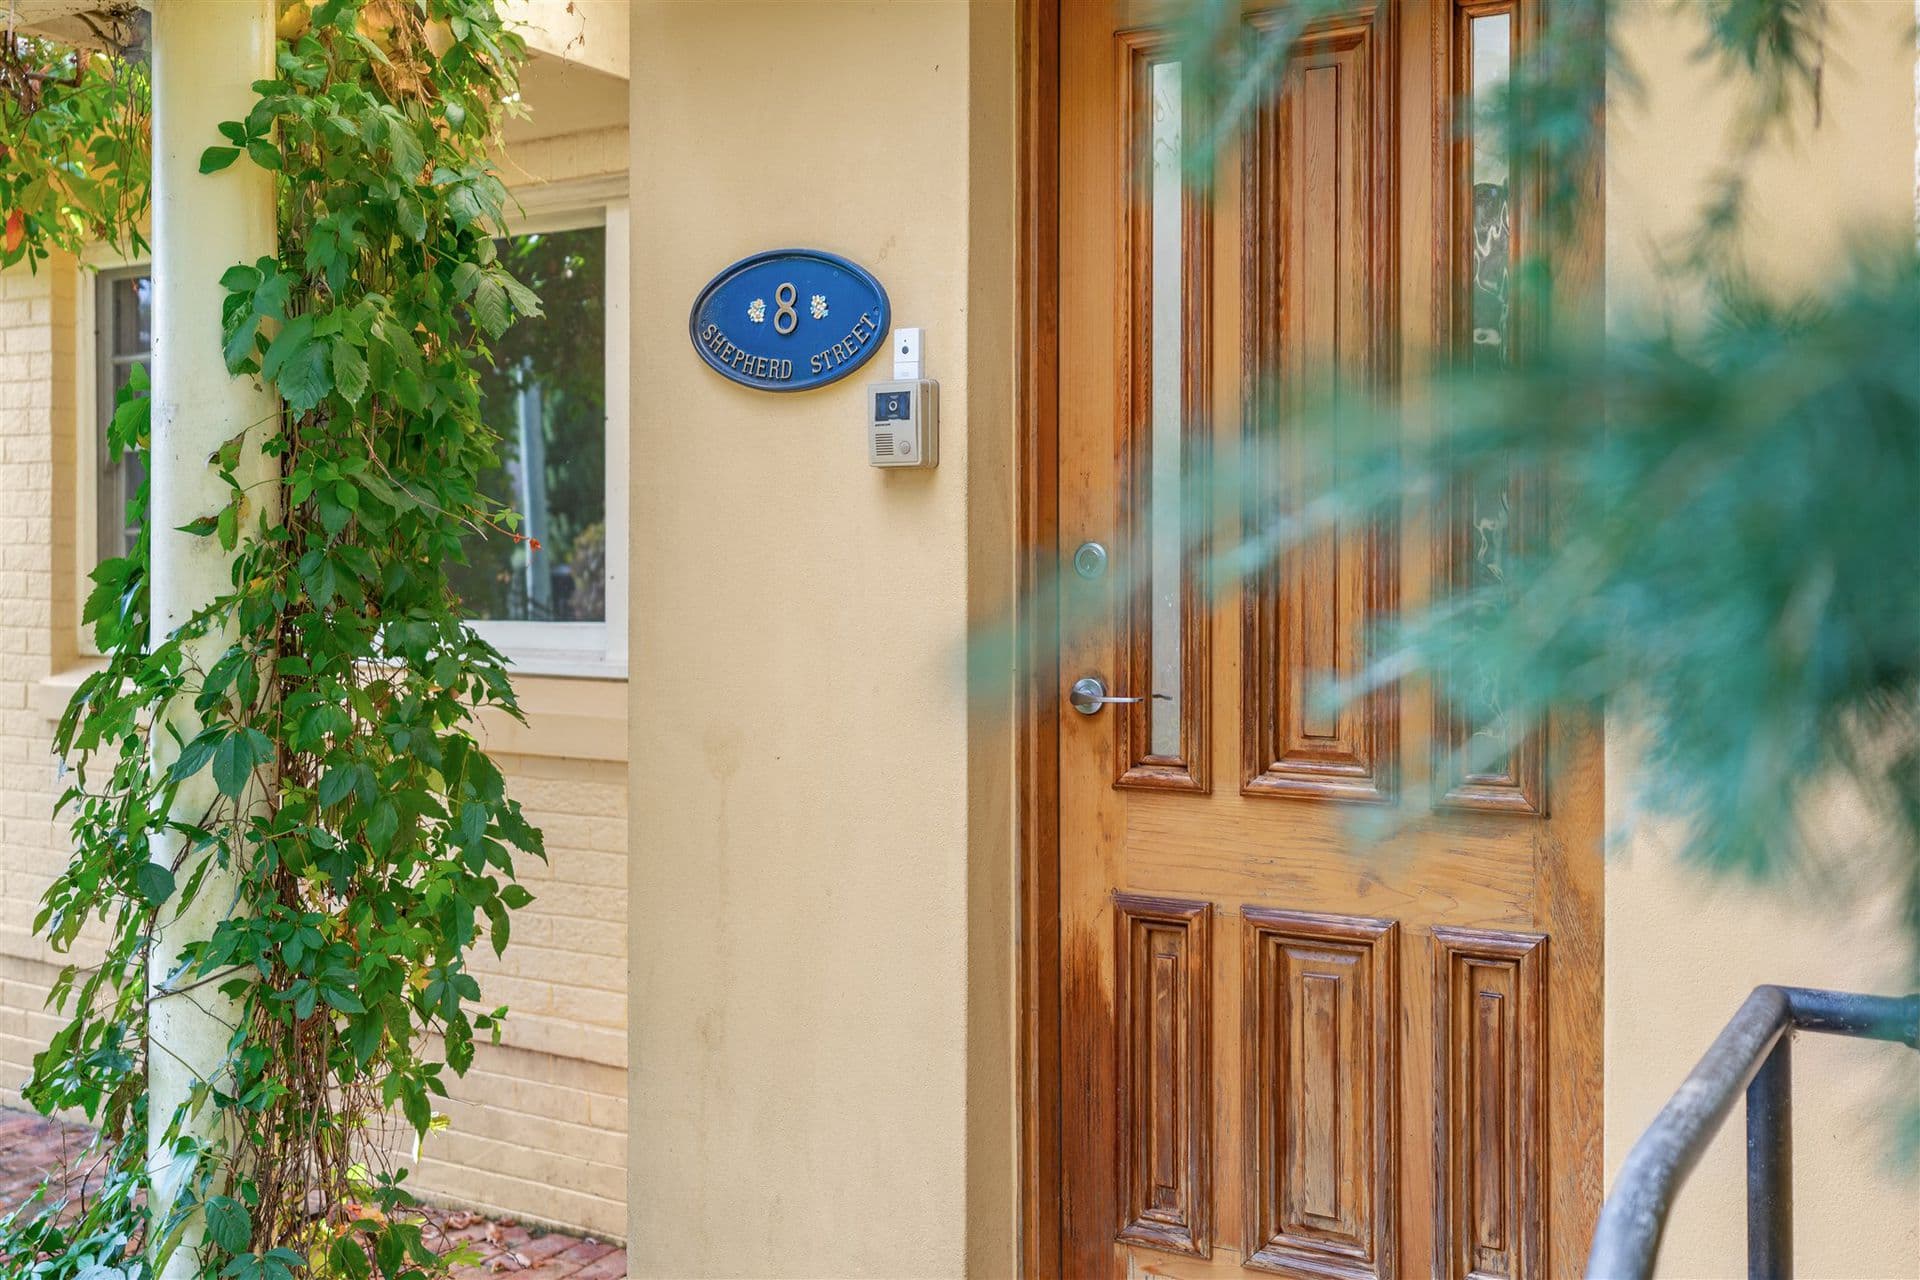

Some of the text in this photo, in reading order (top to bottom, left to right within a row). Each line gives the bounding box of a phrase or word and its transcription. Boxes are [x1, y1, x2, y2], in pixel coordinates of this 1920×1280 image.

[773, 282, 797, 335] 8
[702, 312, 877, 379] SHEPHERD STREET
